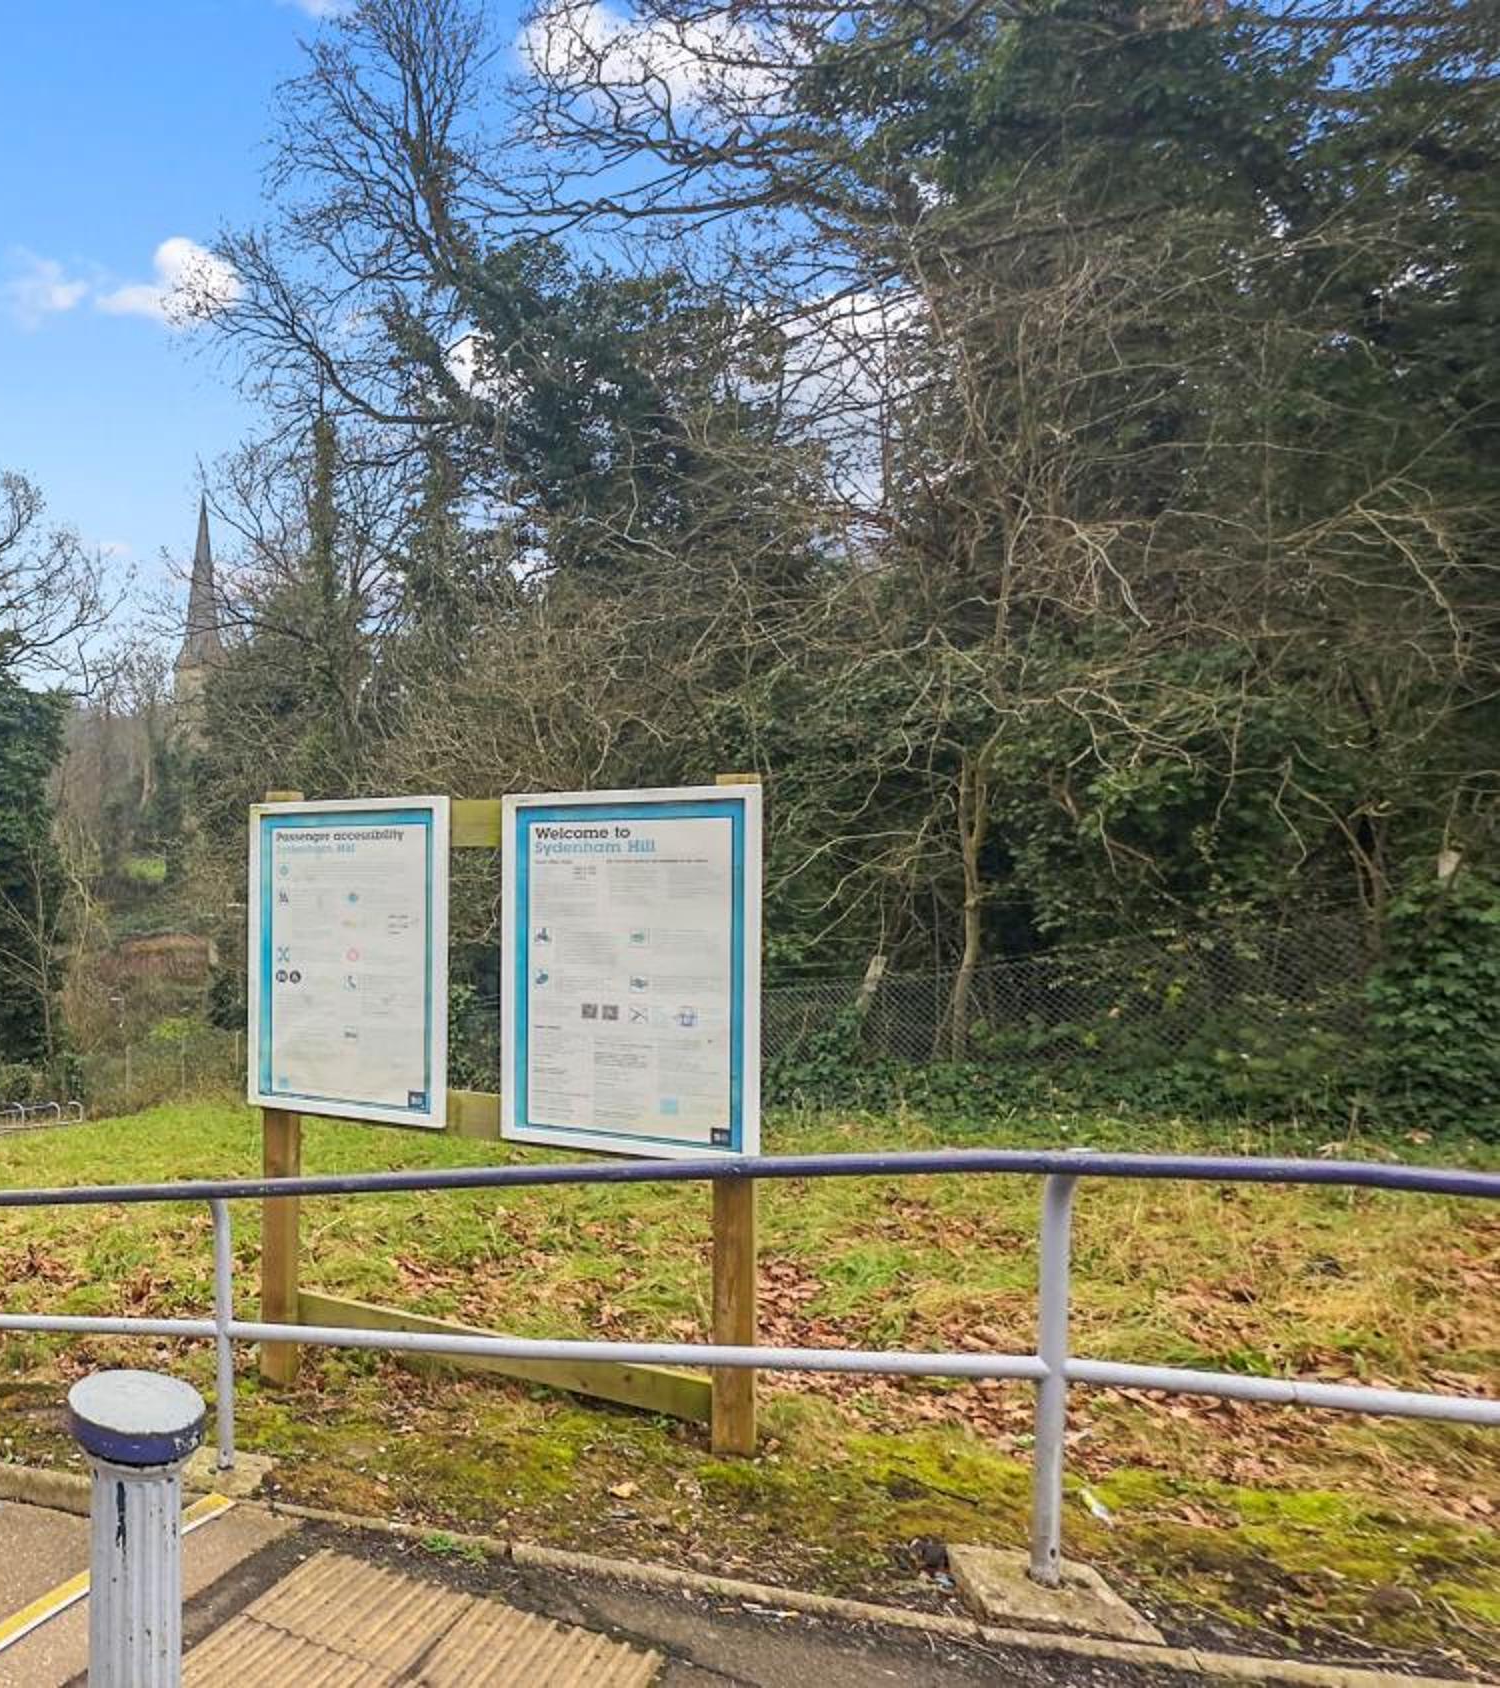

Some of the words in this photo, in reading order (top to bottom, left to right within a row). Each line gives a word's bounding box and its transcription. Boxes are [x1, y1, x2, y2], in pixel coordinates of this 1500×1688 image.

[275, 831, 331, 843] Passenger
[333, 828, 405, 842] accessibility
[535, 827, 609, 840] Welcome
[614, 826, 631, 839] to
[535, 840, 622, 856] Sydenham
[627, 839, 656, 853] Hill
